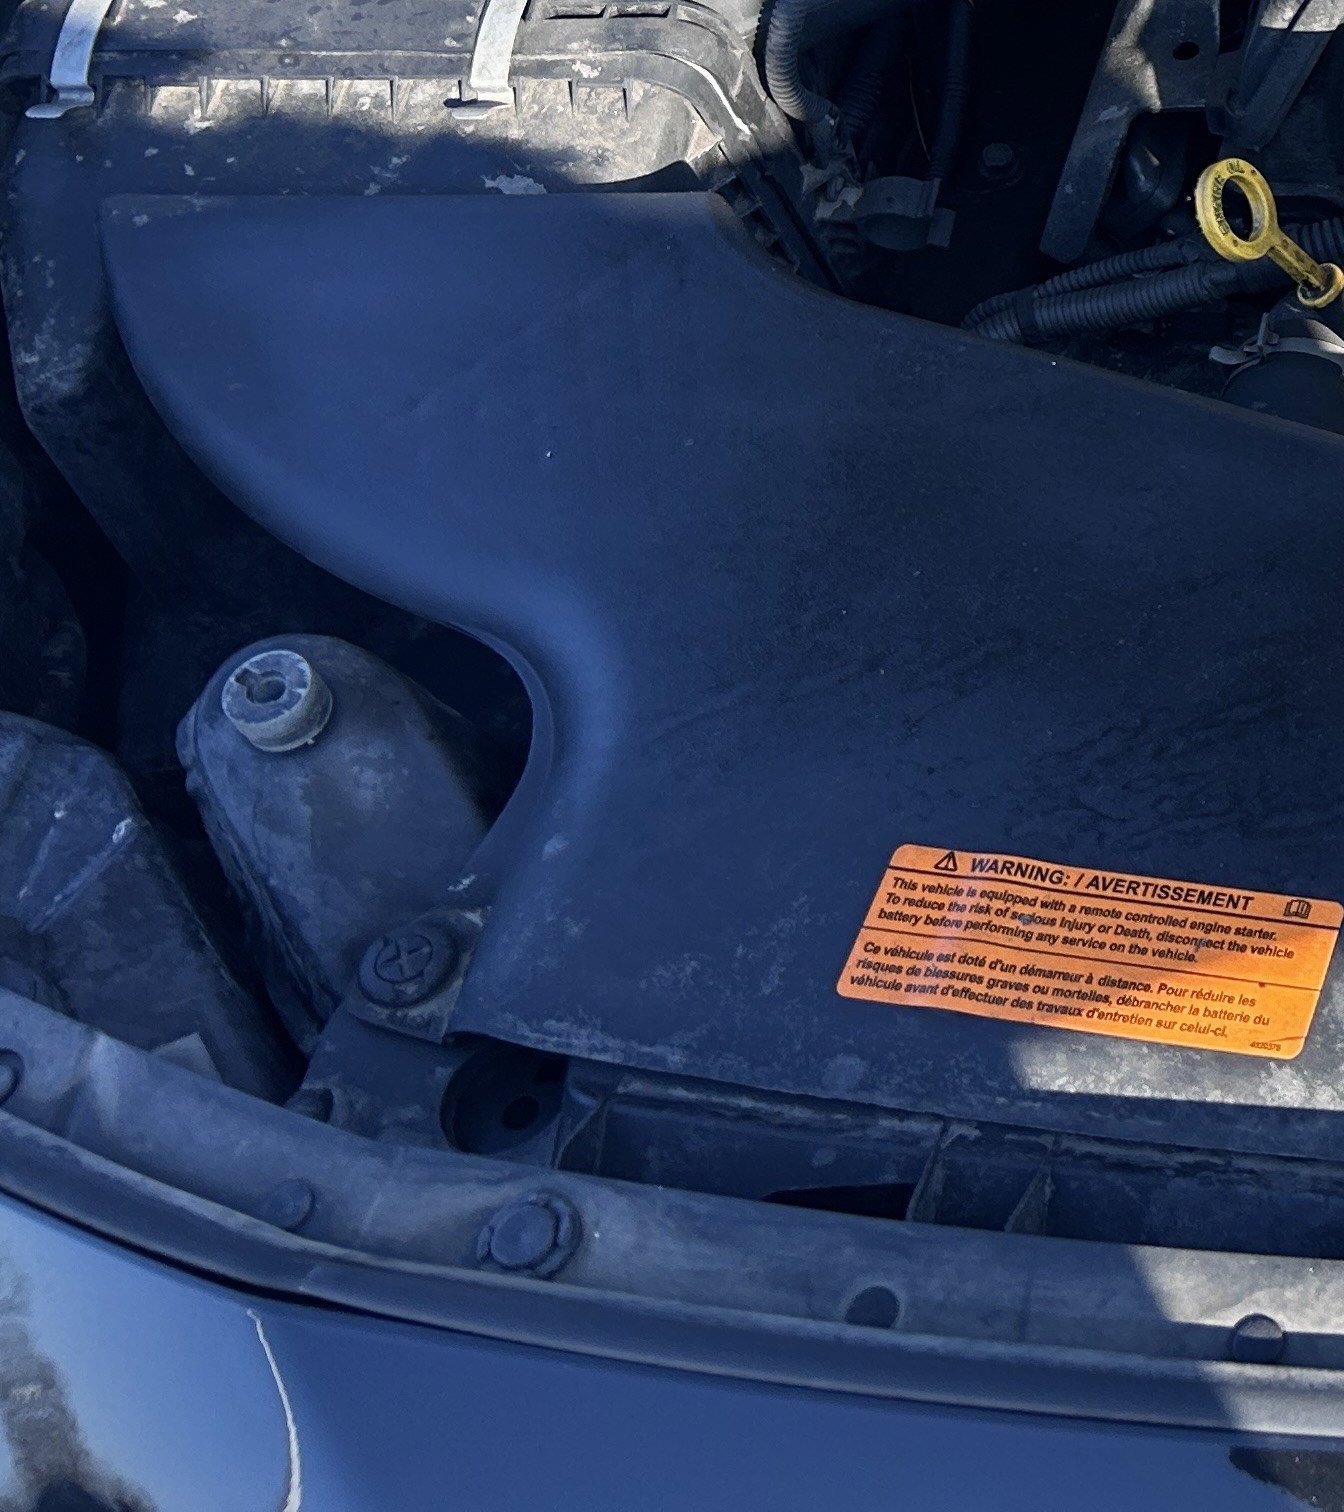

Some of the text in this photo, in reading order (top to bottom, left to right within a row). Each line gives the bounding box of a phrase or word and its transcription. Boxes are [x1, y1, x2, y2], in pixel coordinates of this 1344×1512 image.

[893, 877, 1277, 941] This vehicle is equipped with a remote controlled engine starter.
[971, 857, 1071, 886] WARNING:
[1085, 875, 1254, 911] AVERTISSEMENT
[878, 908, 1197, 963] battery before performing any service on the vehicle.
[886, 892, 901, 905] To
[903, 896, 945, 912] reduce
[947, 899, 966, 913] the
[968, 902, 992, 916] risk
[994, 905, 1010, 918] of
[1097, 924, 1112, 935] or
[1113, 924, 1152, 942] Death,
[1227, 940, 1248, 954] the
[1250, 943, 1294, 959] vehicle
[850, 974, 1228, 1039] véhicule avant d'effectuer des travaux d'entretien sur celui-ci.
[856, 958, 1270, 1027] risques de blessures graves ou mortelles, débrancher la batterie du
[863, 941, 1257, 1007] Ce véhicule est doté d'un démarreur à distance. Pour réduire les
